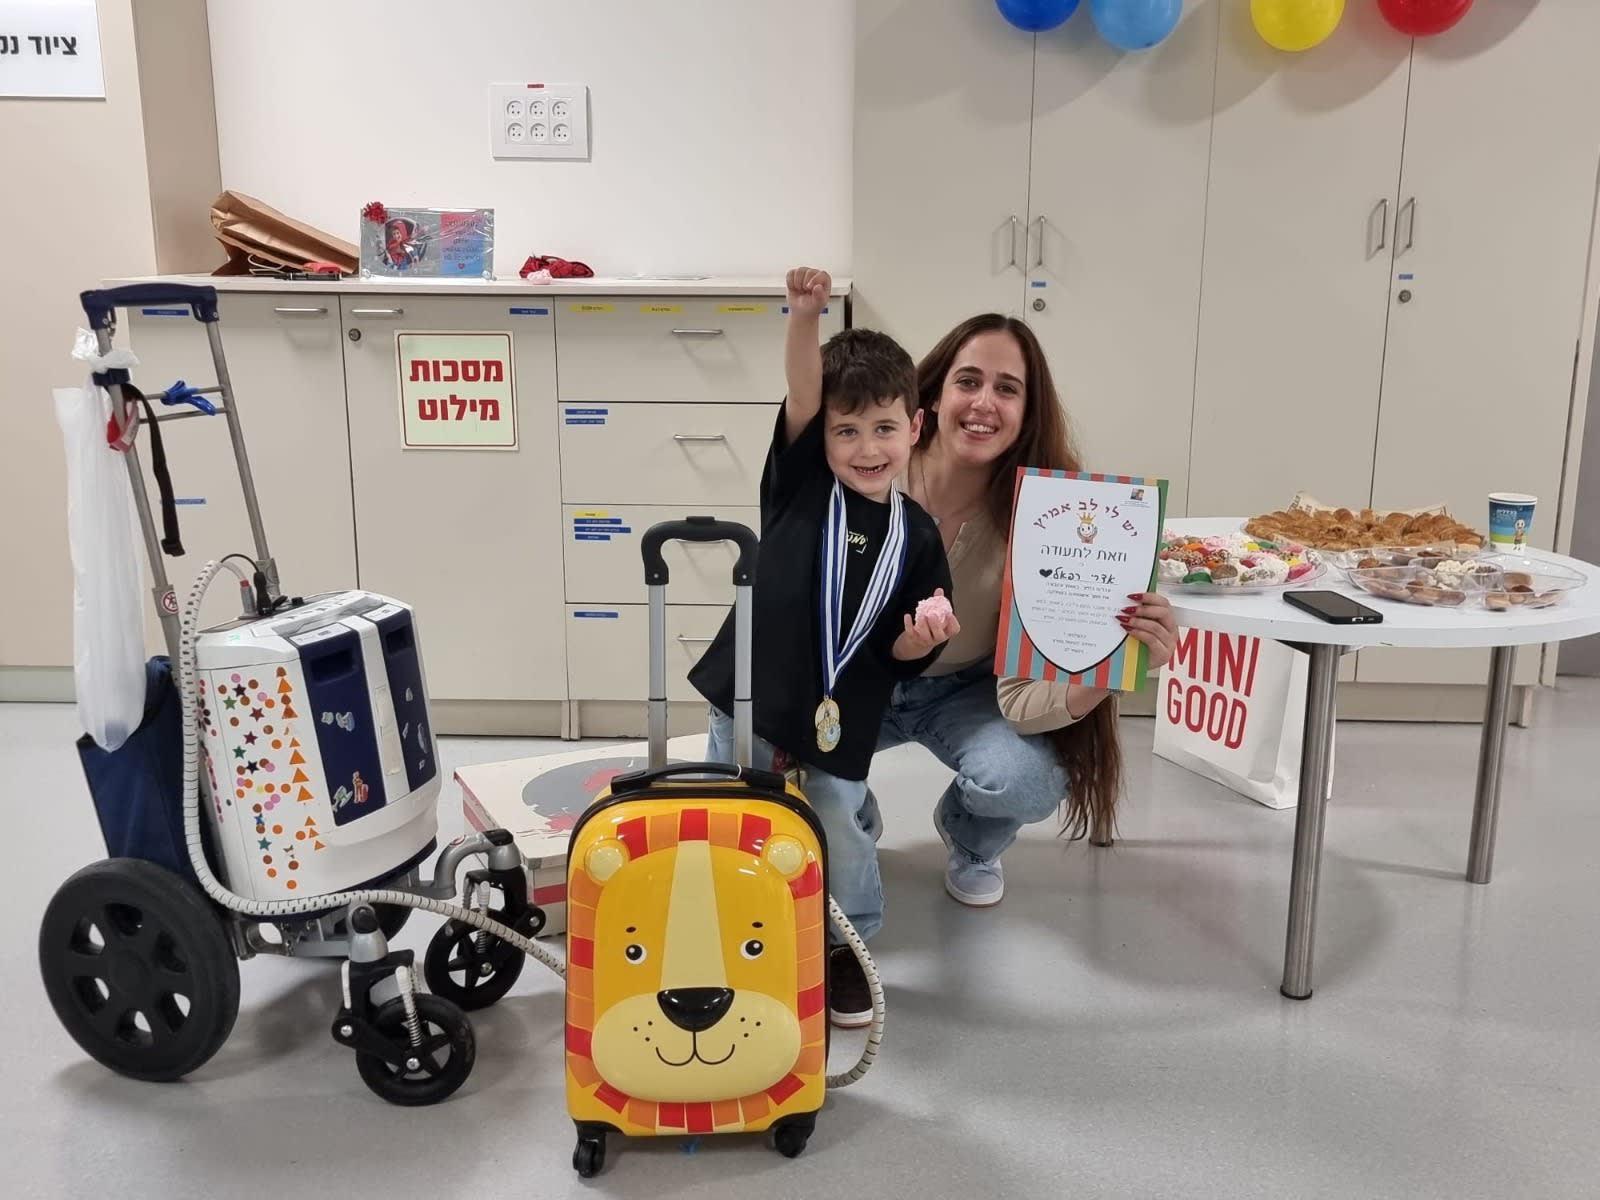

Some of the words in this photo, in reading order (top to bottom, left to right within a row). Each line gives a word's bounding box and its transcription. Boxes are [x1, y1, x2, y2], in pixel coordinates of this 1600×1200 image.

[27, 35, 78, 56] ציוד
[409, 359, 504, 383] מסכות
[418, 394, 500, 421] מילוט
[1078, 497, 1098, 512] לב
[1104, 504, 1120, 519] לי
[1033, 502, 1072, 530] אמיץ
[1122, 519, 1138, 537] יש
[848, 534, 866, 545] UND
[1040, 544, 1092, 559] לתעודה
[1097, 549, 1128, 562] וזאת
[1053, 566, 1081, 581] רפאל
[1168, 627, 1261, 698] MINI
[1167, 677, 1248, 750] GOOD
